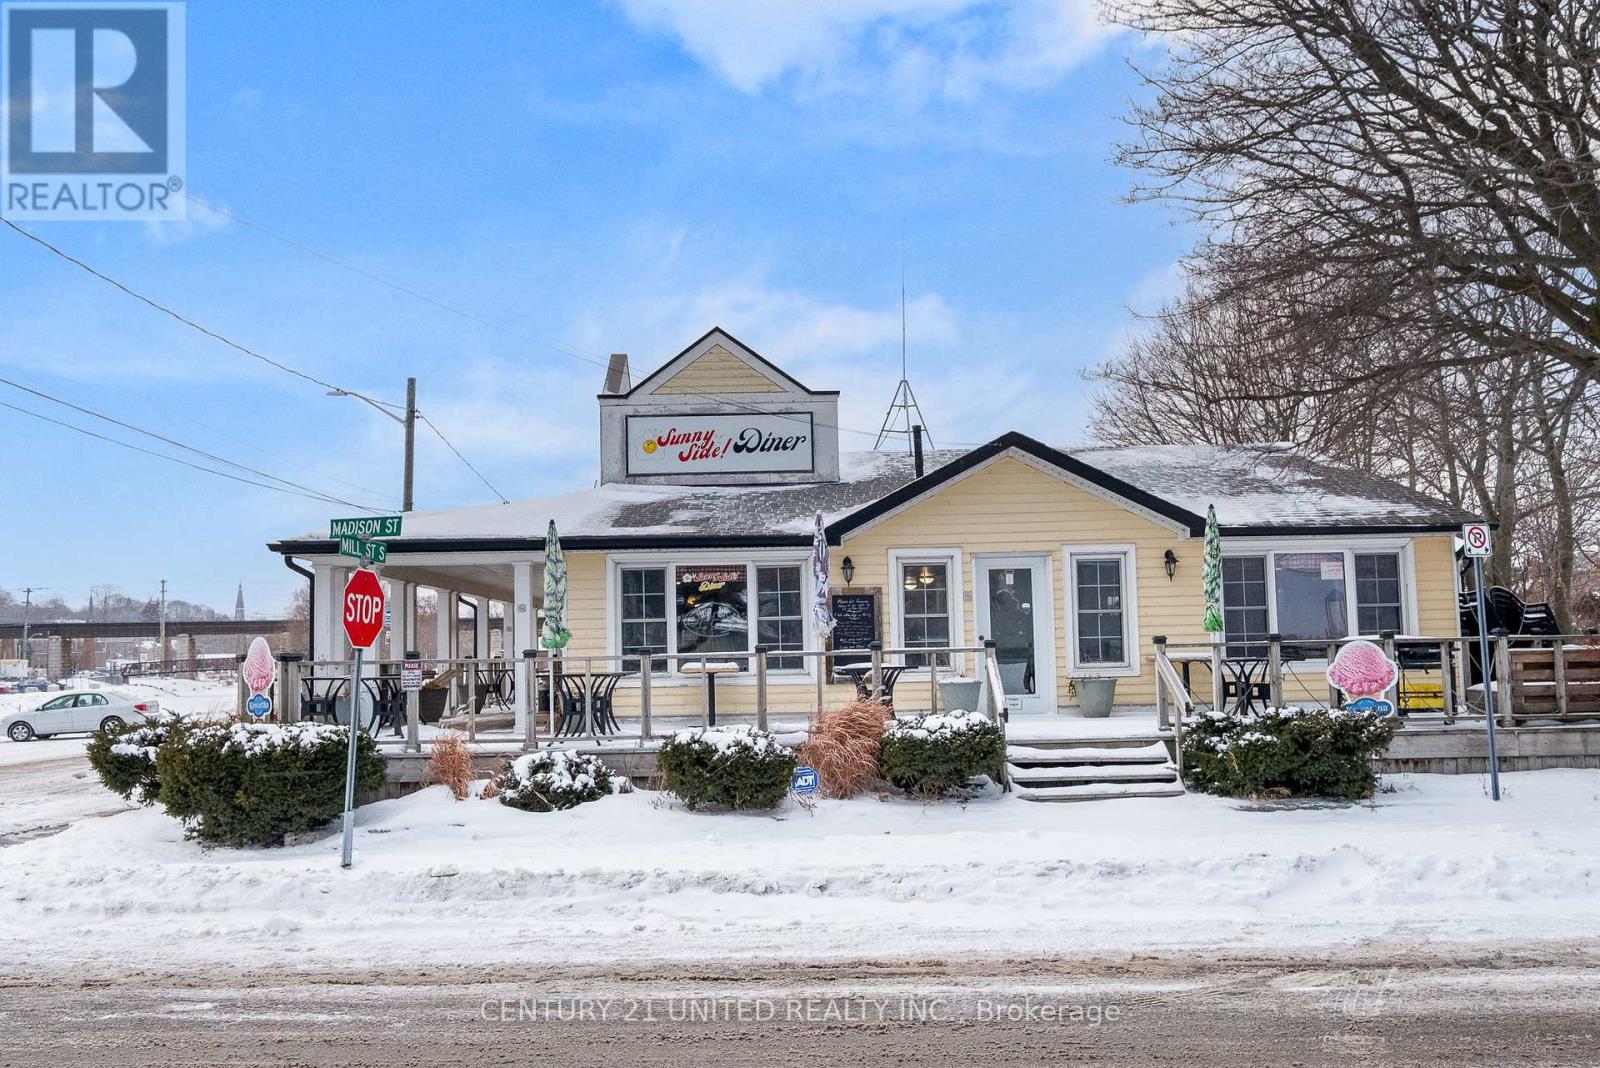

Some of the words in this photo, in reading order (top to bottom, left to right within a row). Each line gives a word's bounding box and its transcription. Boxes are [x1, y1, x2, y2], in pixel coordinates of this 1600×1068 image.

[656, 427, 715, 450] Sunny
[678, 437, 733, 462] Side!
[732, 427, 807, 454] Diner
[332, 519, 381, 536] MADISON
[385, 518, 400, 534] ST
[341, 538, 362, 556] MILL
[365, 543, 376, 559] ST
[379, 546, 385, 561] S
[346, 593, 381, 624] STOP
[796, 775, 814, 786] ADT
